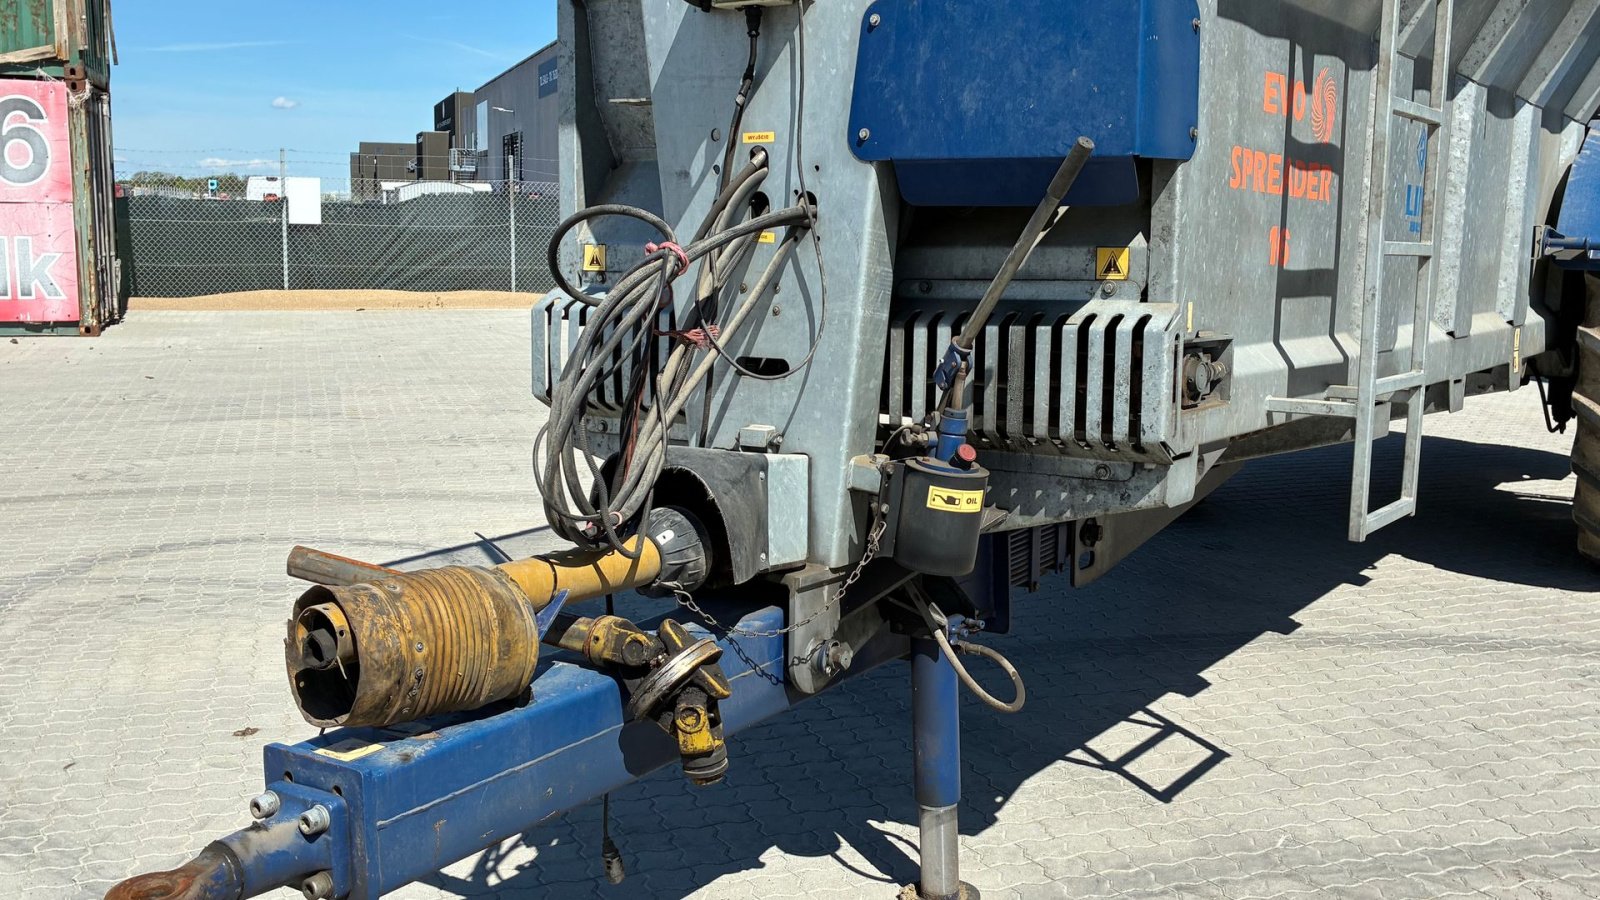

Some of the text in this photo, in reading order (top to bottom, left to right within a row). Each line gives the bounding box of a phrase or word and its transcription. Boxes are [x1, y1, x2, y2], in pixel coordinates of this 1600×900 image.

[1264, 71, 1306, 121] EVO
[0, 94, 51, 187] 6
[1229, 145, 1333, 203] SPREADER
[1269, 225, 1291, 267] 16
